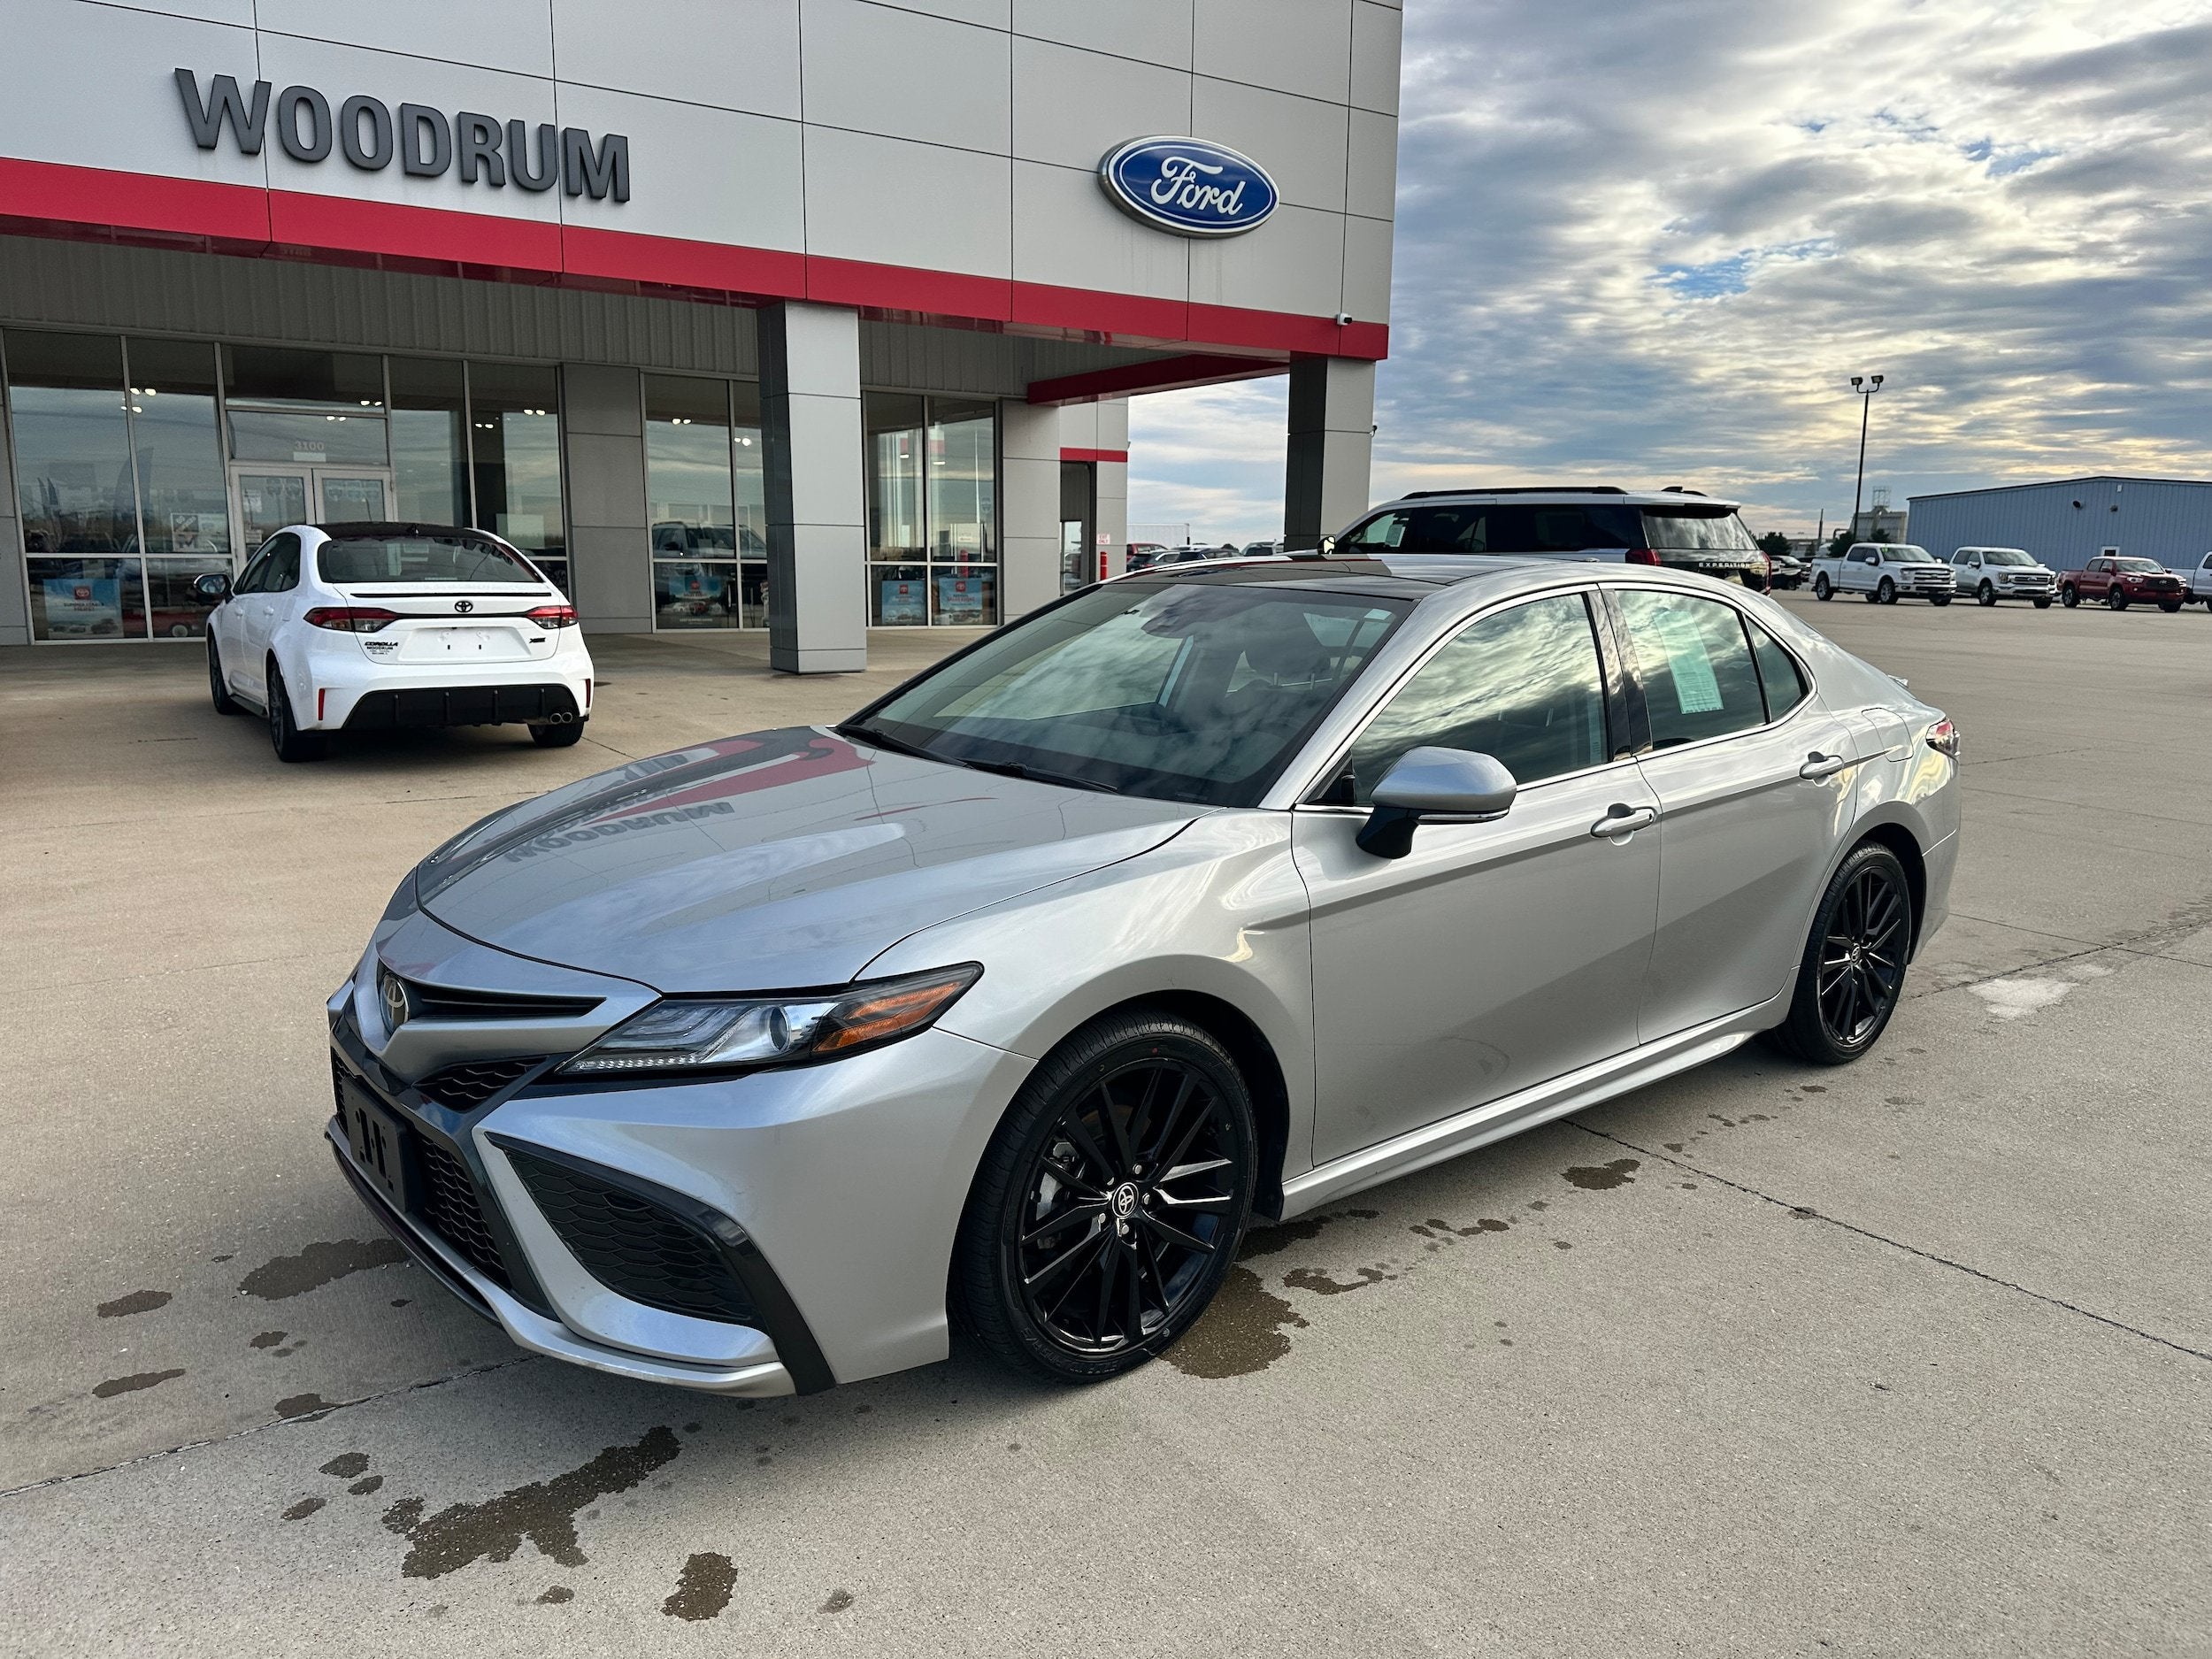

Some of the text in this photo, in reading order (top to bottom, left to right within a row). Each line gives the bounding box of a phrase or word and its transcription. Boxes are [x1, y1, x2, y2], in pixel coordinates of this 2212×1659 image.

[174, 67, 631, 204] WOODRUM
[1150, 156, 1246, 216] Ford
[295, 441, 326, 451] 3100
